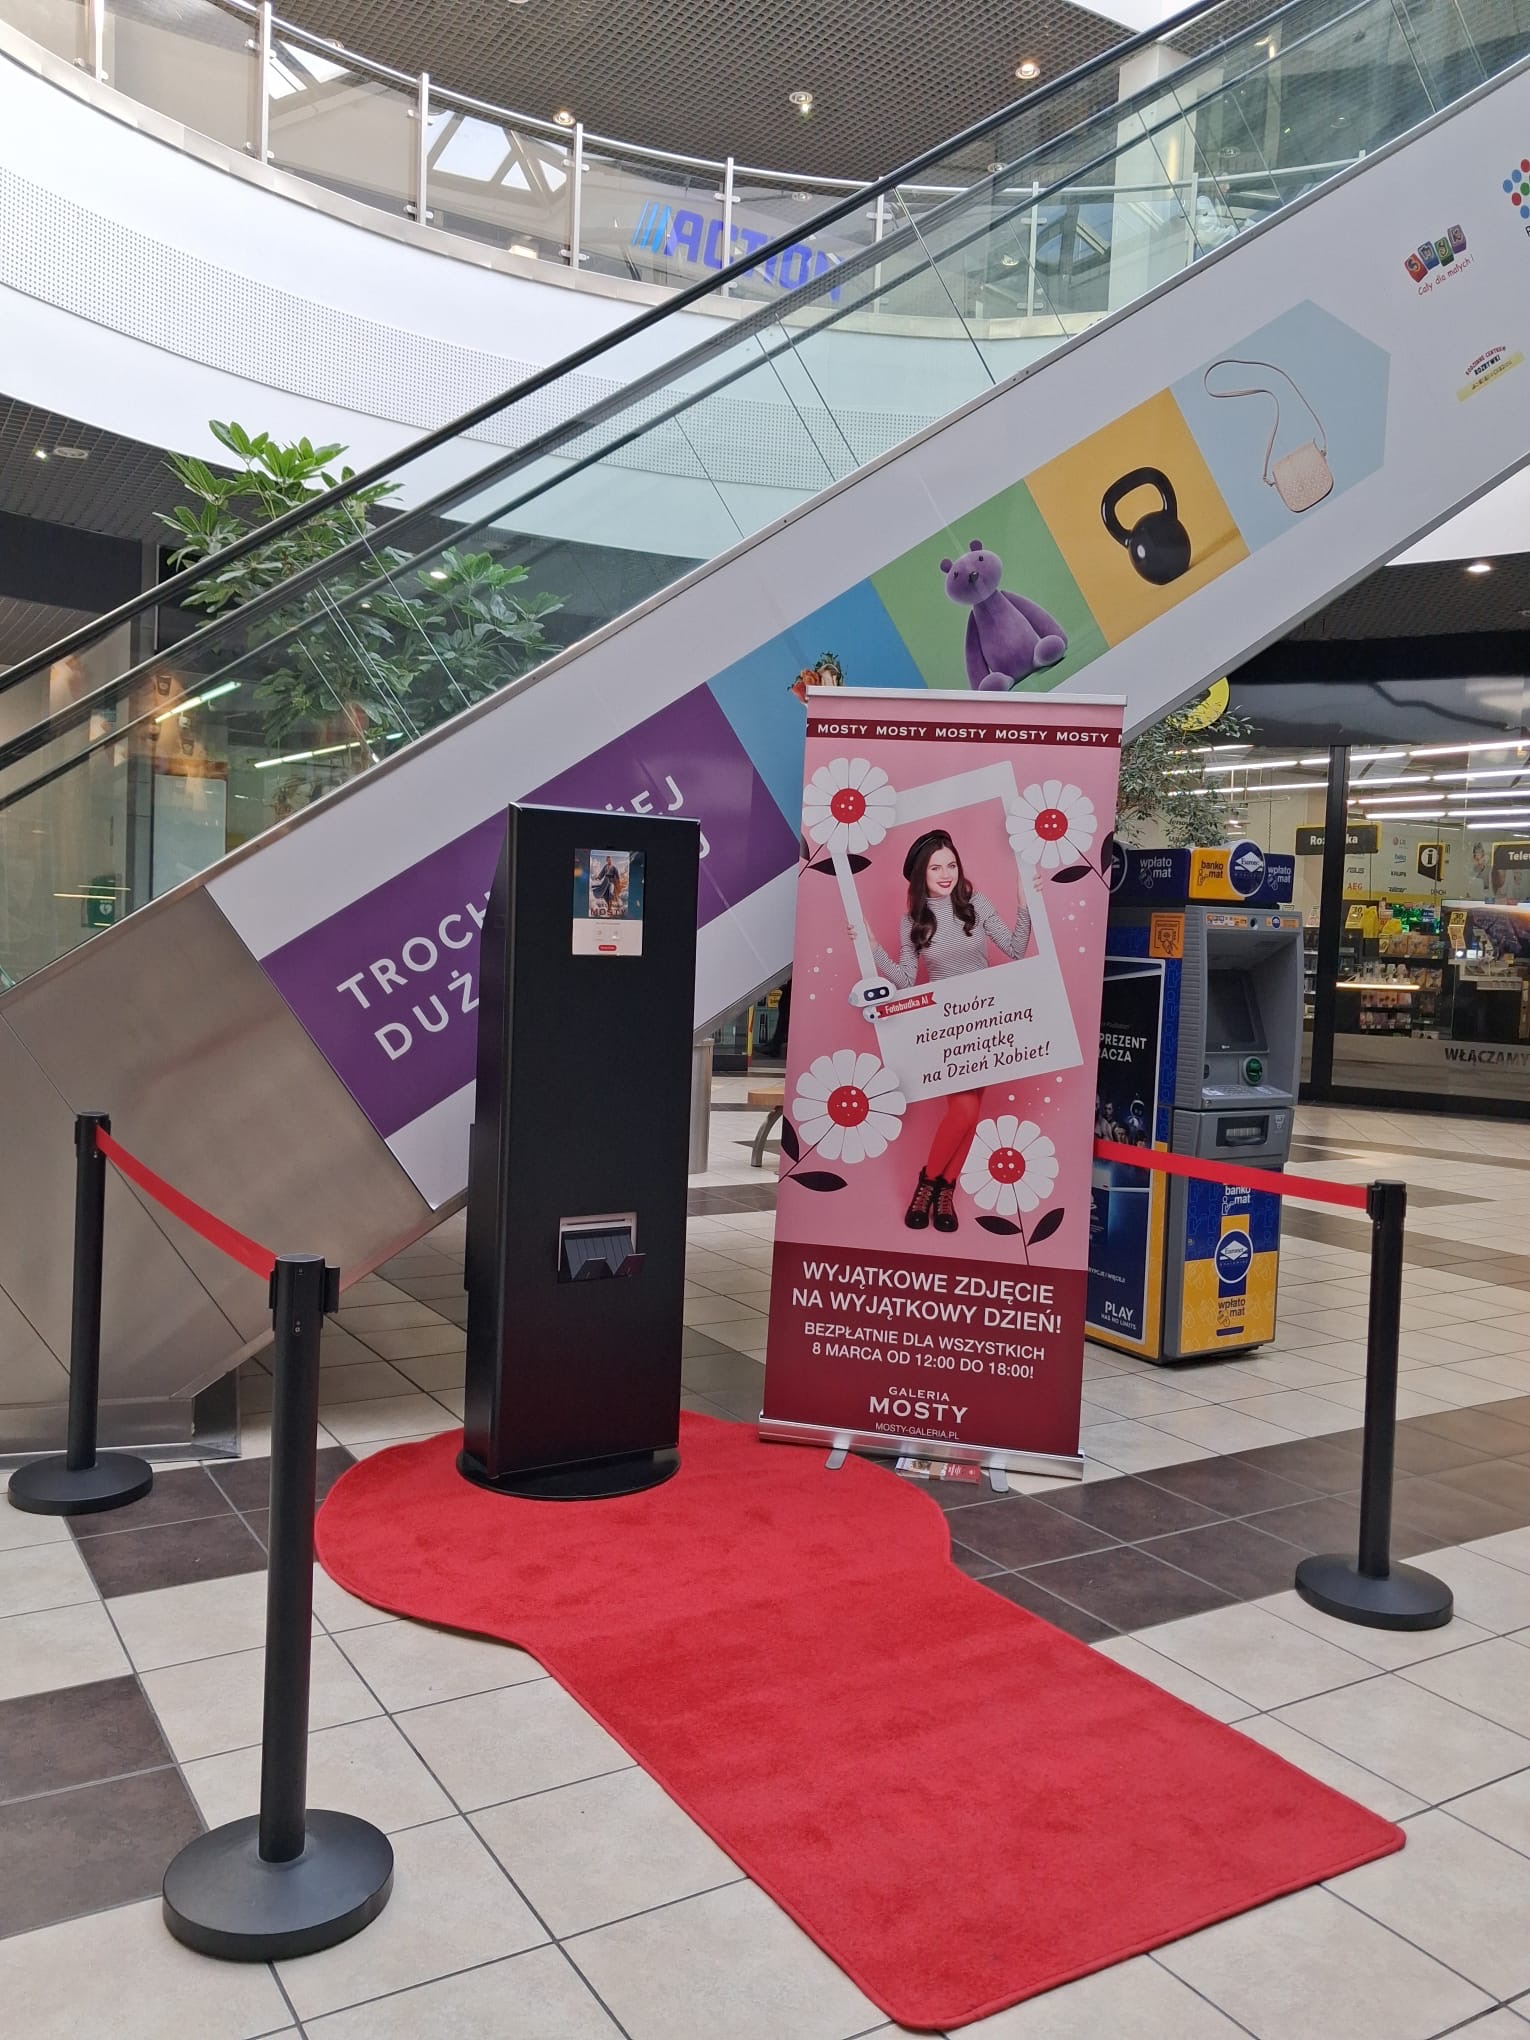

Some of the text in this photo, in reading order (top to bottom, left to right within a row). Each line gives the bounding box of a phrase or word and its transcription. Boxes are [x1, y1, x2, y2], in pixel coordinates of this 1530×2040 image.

[817, 723, 868, 735] MOSTY
[876, 725, 927, 737] MOSTY
[935, 727, 987, 739] MOSTY
[995, 729, 1048, 741] MOSTY
[1056, 731, 1109, 743] MOSTY
[1139, 856, 1172, 870] wpłato
[1508, 850, 1530, 861] Tele
[1153, 868, 1172, 878] mat
[1201, 860, 1224, 871] banko
[1208, 870, 1224, 879] mat
[1267, 865, 1292, 876] wpłato
[1277, 875, 1291, 884] mat
[374, 969, 480, 1061] DUŻ
[885, 996, 929, 1015] Fotobudka AI
[943, 995, 996, 1018] Stwórz
[915, 1007, 1034, 1045] niezapomnianą
[943, 1030, 1015, 1063] pamiątkę
[1099, 1047, 1132, 1062] ACZA
[922, 1041, 1051, 1084] na Dzień Kobiet!
[1234, 1194, 1251, 1205] mat
[802, 1261, 1054, 1305] WYJĄTKOWE ZDJĘCIE
[792, 1288, 1062, 1334] NA WYJĄTKOWY DZIEŃ!
[1104, 1300, 1134, 1322] PLAY
[1217, 1298, 1246, 1311] wpłato
[1229, 1307, 1245, 1318] mat
[804, 1322, 1045, 1361] BEZPŁATNIE DLA WSZYSTKICH
[811, 1342, 1034, 1379] 8 MARCA OD 12:00 DO 18:00!
[888, 1386, 950, 1402] GALERIA
[869, 1396, 968, 1424] MOSTY
[875, 1421, 960, 1440] MOSTY-GALERIA.PL
